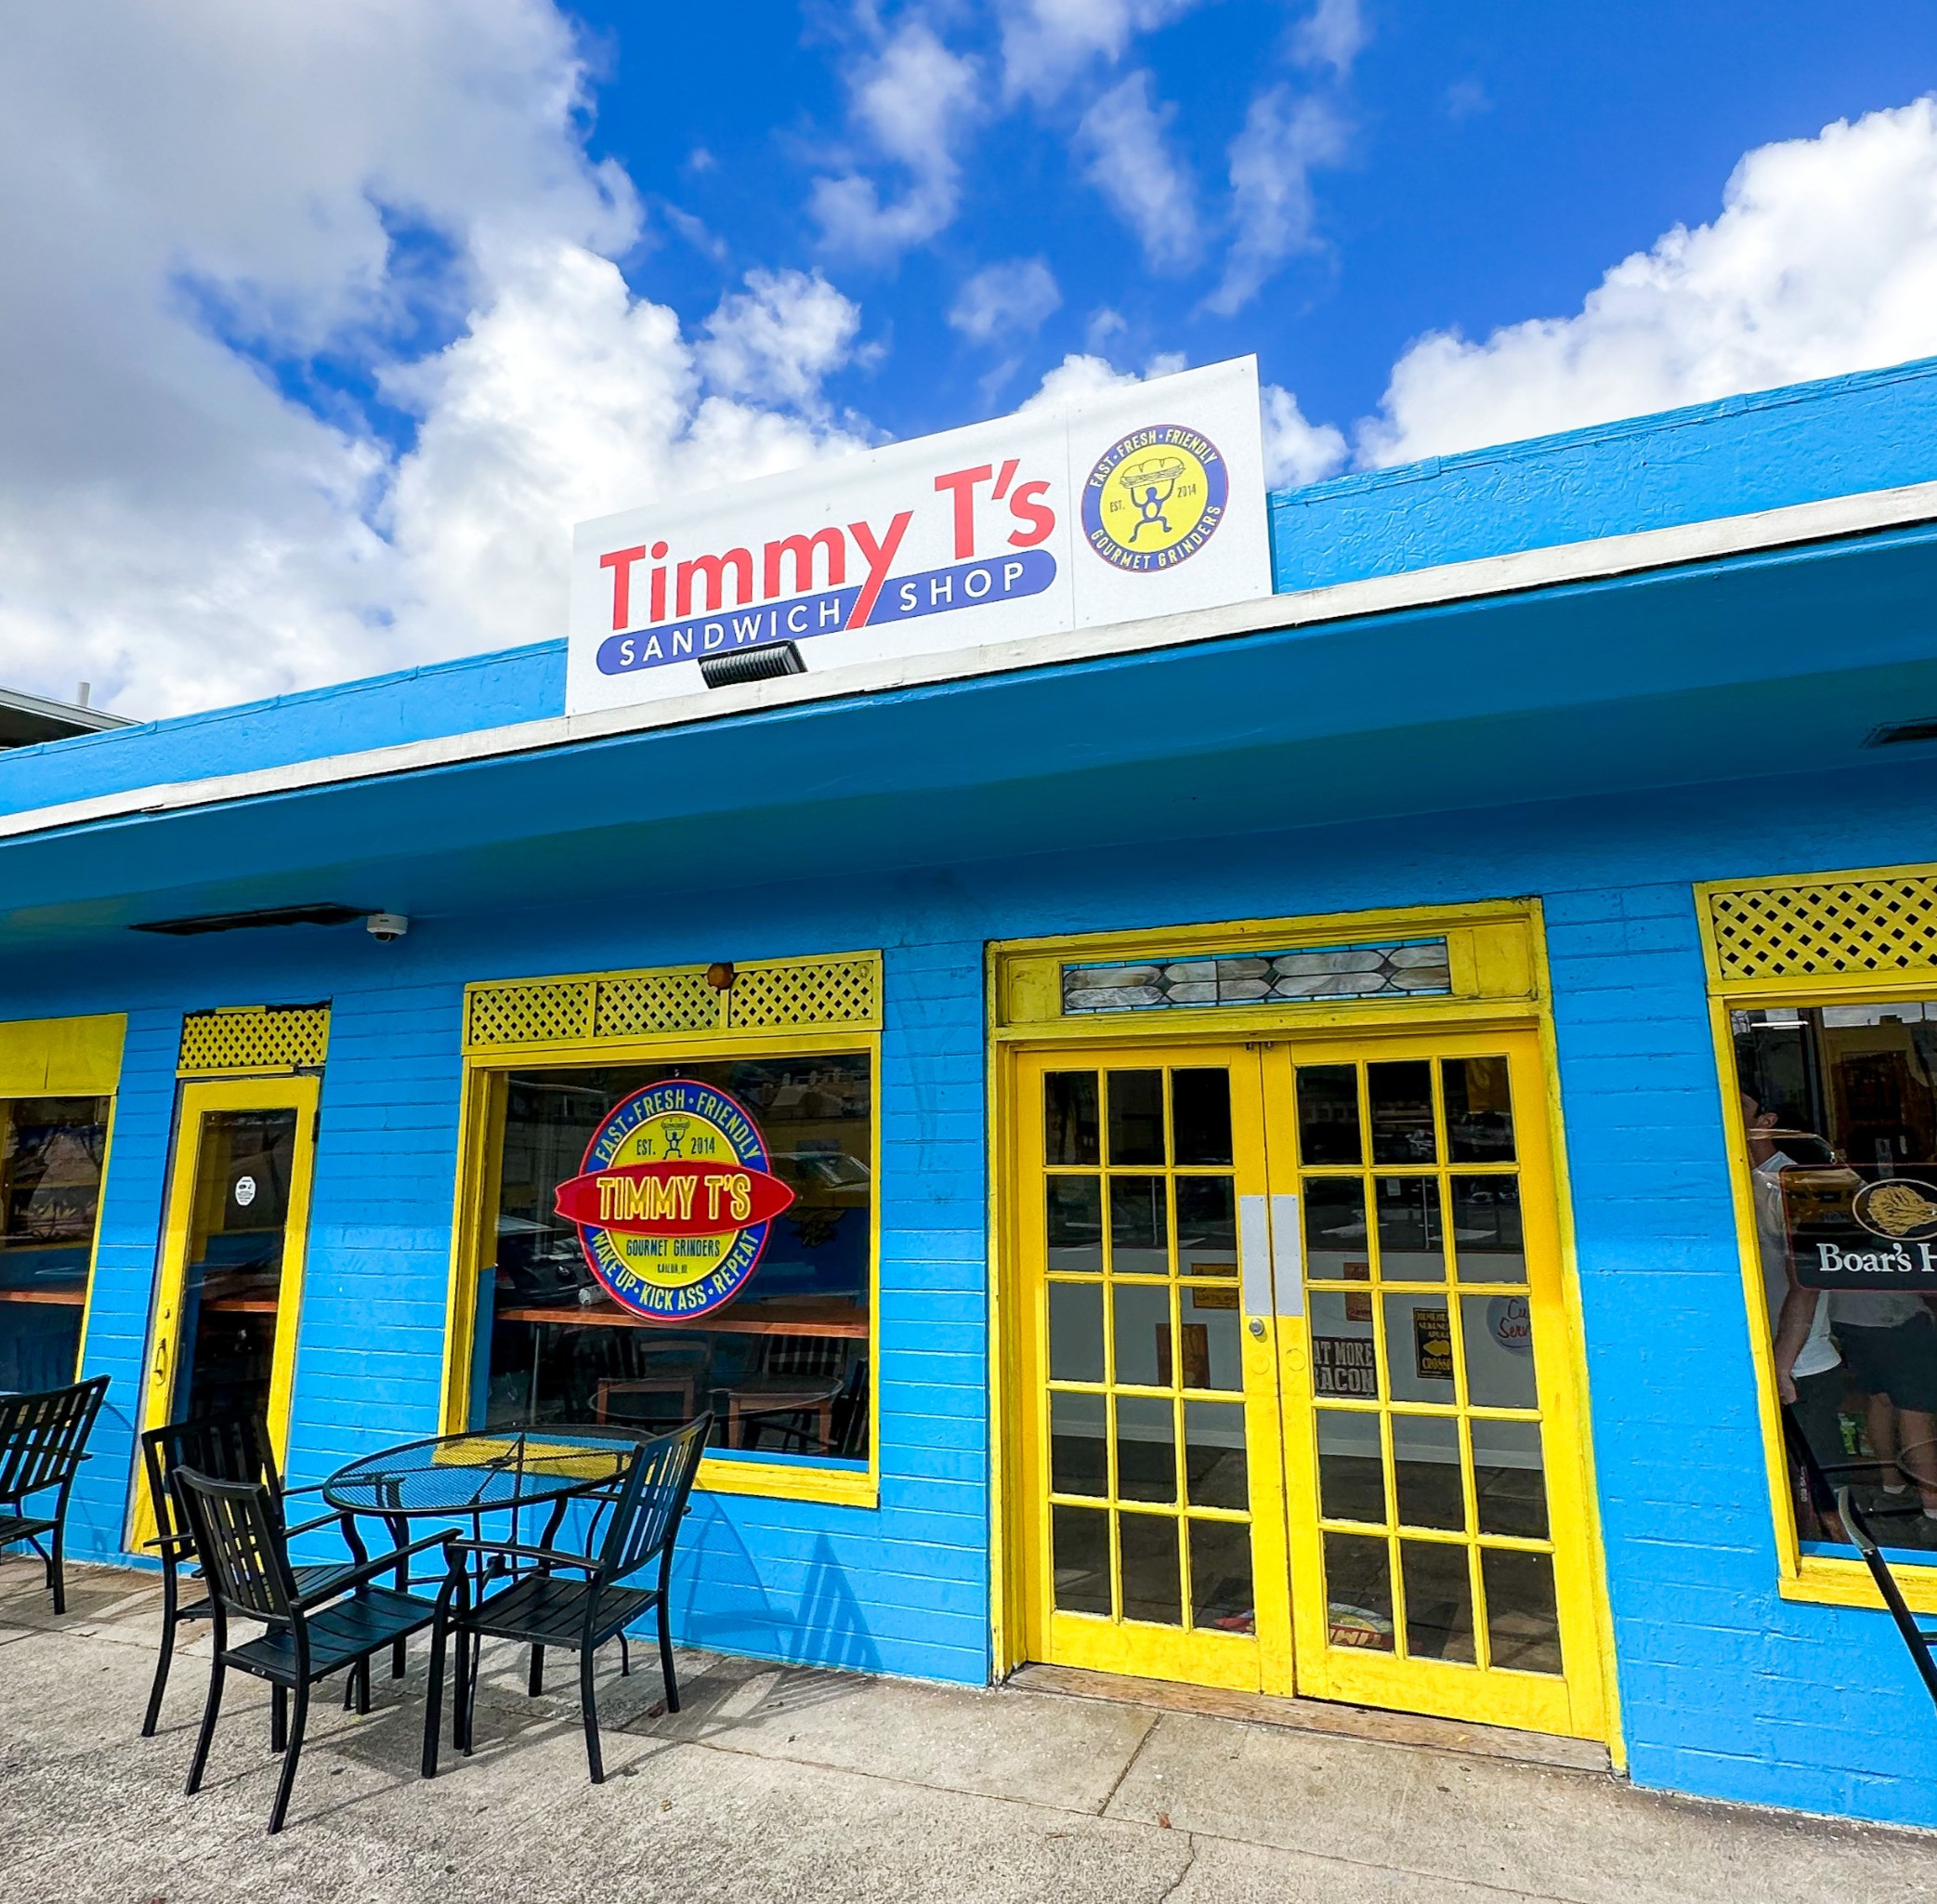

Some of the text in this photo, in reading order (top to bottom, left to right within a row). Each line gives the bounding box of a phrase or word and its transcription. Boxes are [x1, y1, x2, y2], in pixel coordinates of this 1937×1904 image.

[1090, 428, 1218, 488] FAST FRESH FRIENDLY
[1109, 483, 1197, 513] EST. 2014
[599, 458, 1055, 631] Timmy T's
[1091, 506, 1221, 569] GOURMET GRINDERS
[619, 561, 1025, 667] SANDWICH SHOP
[595, 1089, 762, 1162] FAST FRESH FRIENDLY
[636, 1136, 715, 1155] EST. 2014
[596, 1173, 751, 1221] TIMMY T'S
[626, 1239, 720, 1256] GOURMET GRINDERS
[1816, 1242, 1912, 1273] Boar's
[591, 1229, 759, 1311] WAKE UP KICK ASS REPEAT
[1498, 1316, 1529, 1338] Serv
[1507, 1298, 1527, 1320] Cu
[1313, 1340, 1373, 1367] AT MORE
